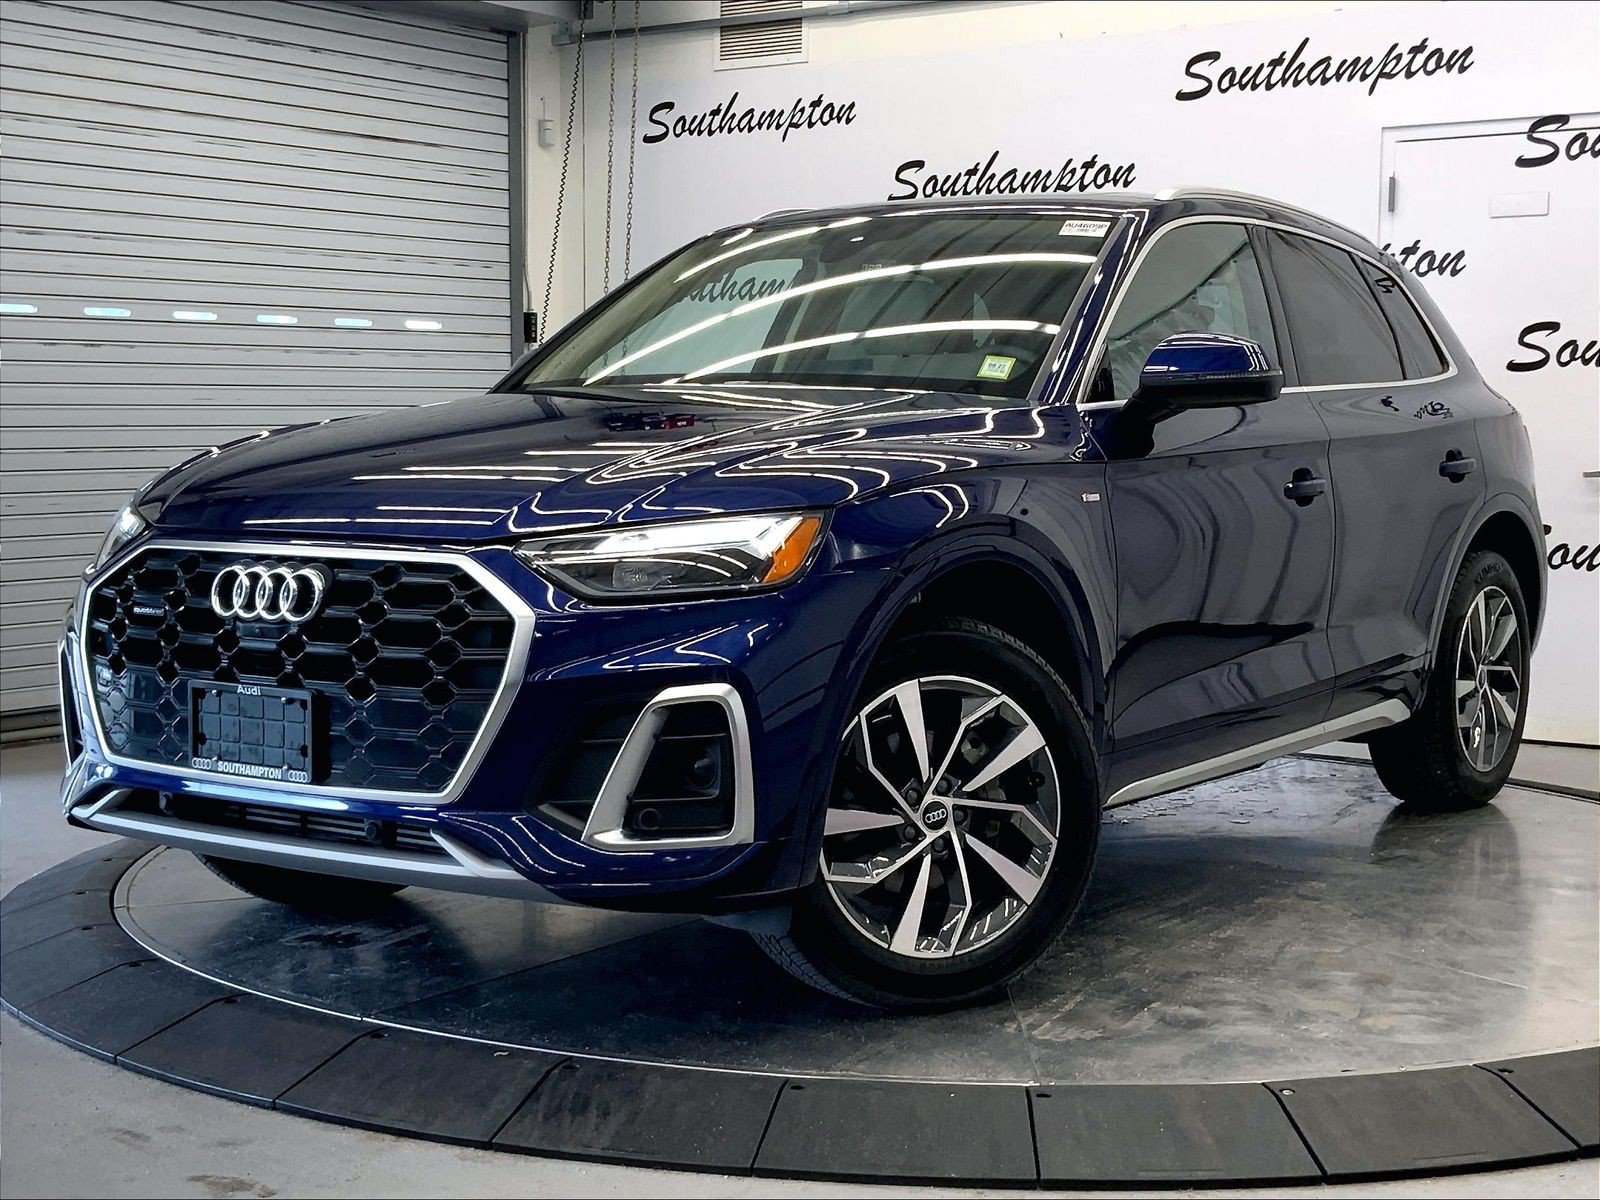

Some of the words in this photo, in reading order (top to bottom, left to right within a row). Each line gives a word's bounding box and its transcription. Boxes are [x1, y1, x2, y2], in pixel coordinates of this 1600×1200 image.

[1175, 37, 1475, 101] Southampton
[642, 91, 857, 144] Southampton
[887, 150, 1137, 201] Southampton
[236, 685, 262, 695] Audi
[217, 761, 282, 779] SOUTHAMPTON
